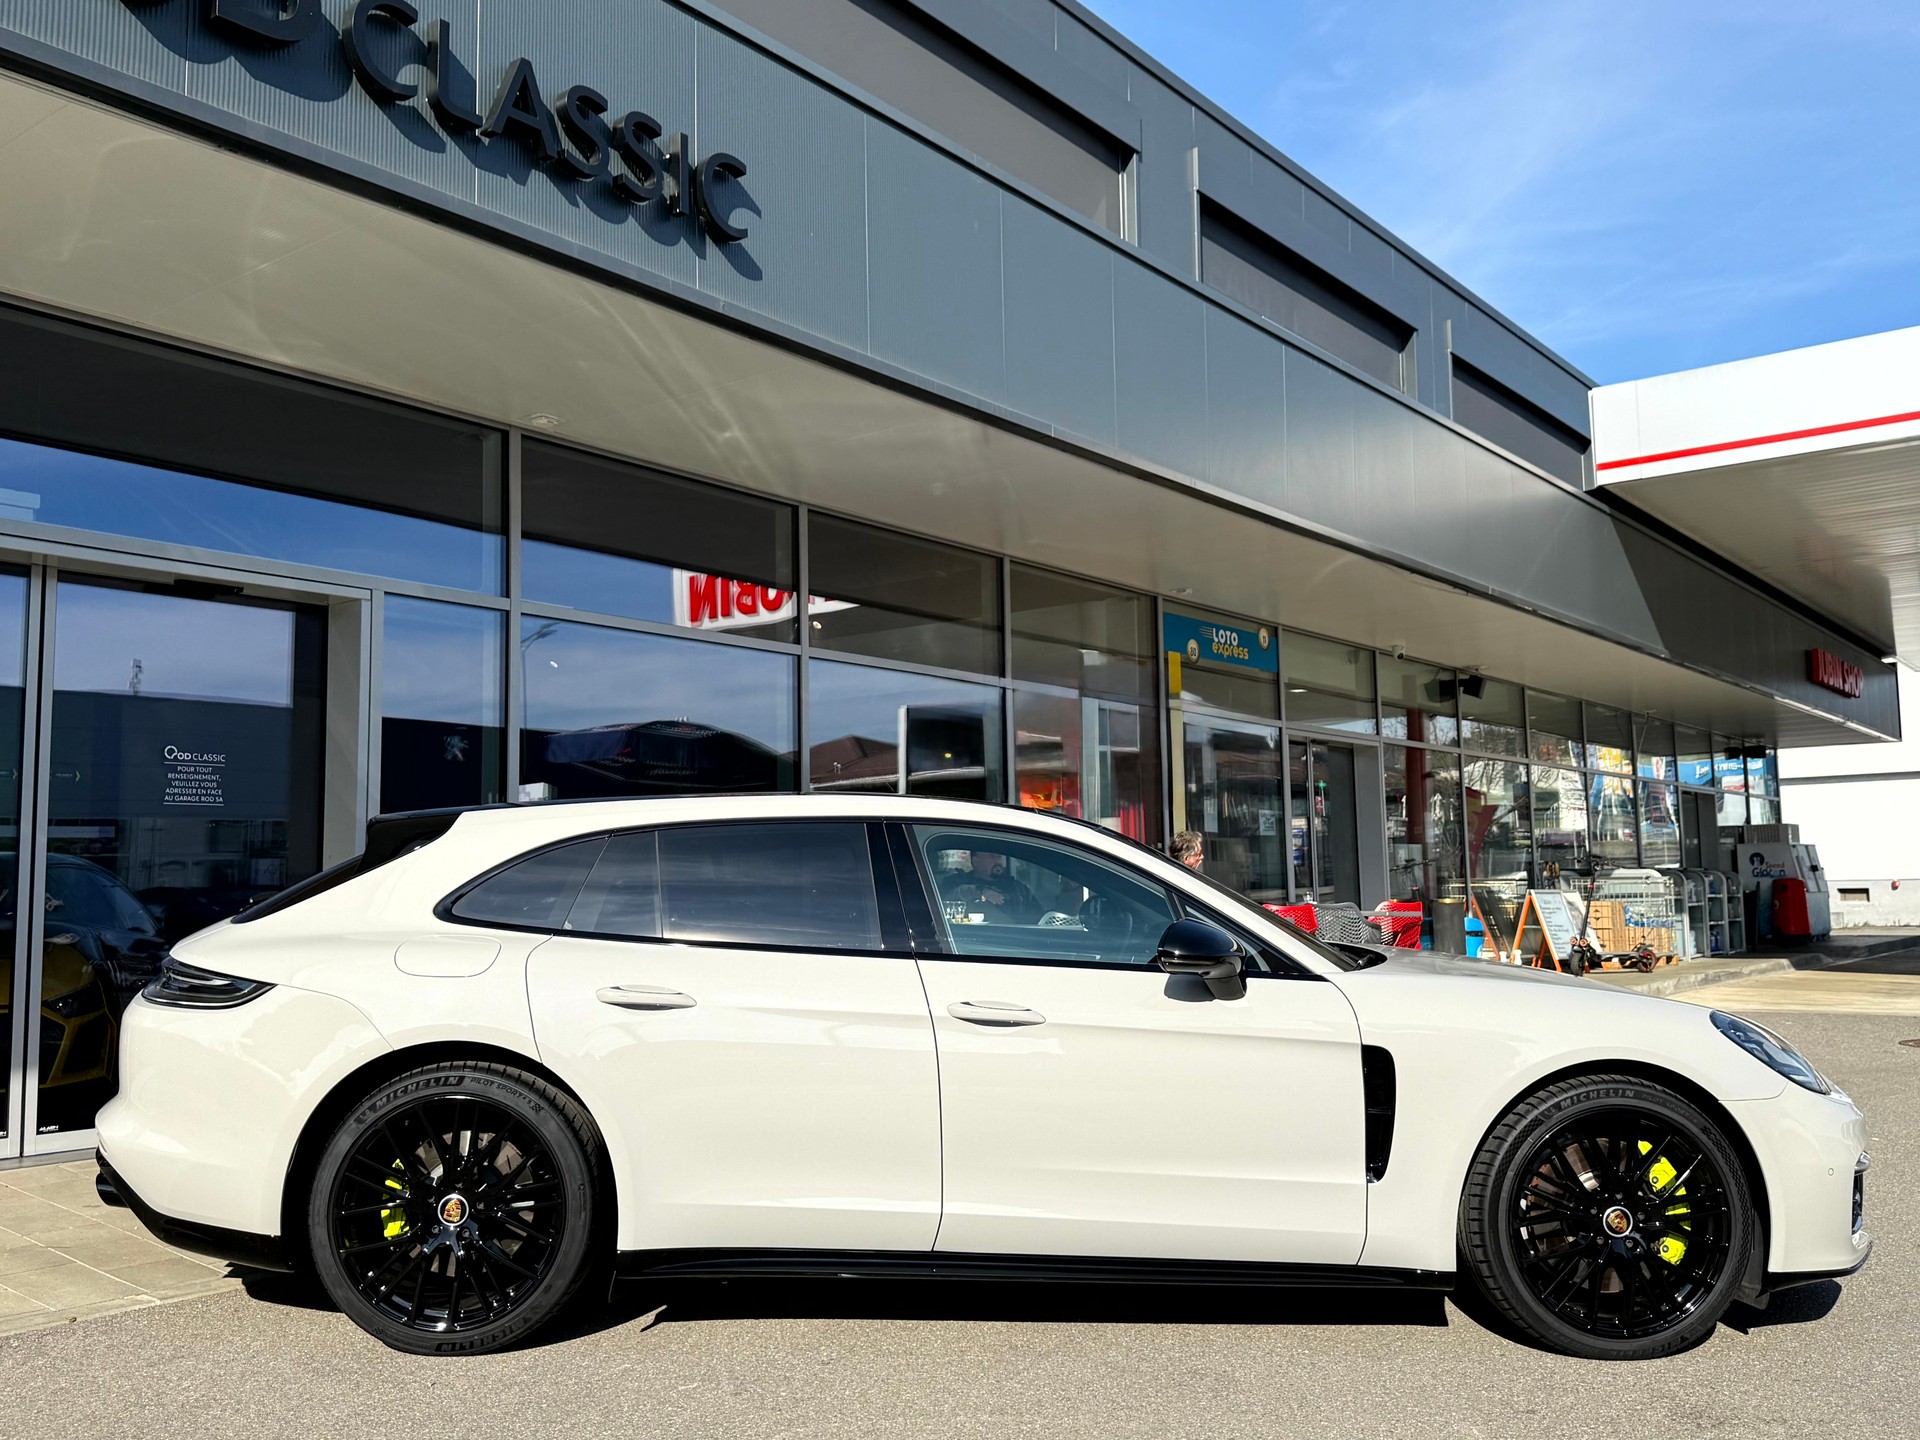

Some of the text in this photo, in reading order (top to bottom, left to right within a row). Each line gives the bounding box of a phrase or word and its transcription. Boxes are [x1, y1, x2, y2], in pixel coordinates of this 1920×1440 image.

[342, 0, 748, 243] CLASSIC
[1212, 627, 1239, 646] LOTO
[1211, 641, 1249, 660] express
[1843, 660, 1864, 698] SHOP
[192, 753, 226, 762] CLASSIC
[167, 773, 221, 781] RENSEIGNEMENT,
[375, 1075, 460, 1109] MICHELIN
[470, 1077, 495, 1088] PILOT
[495, 1083, 523, 1099] SPORT
[1560, 1088, 1635, 1110] MICHELIN
